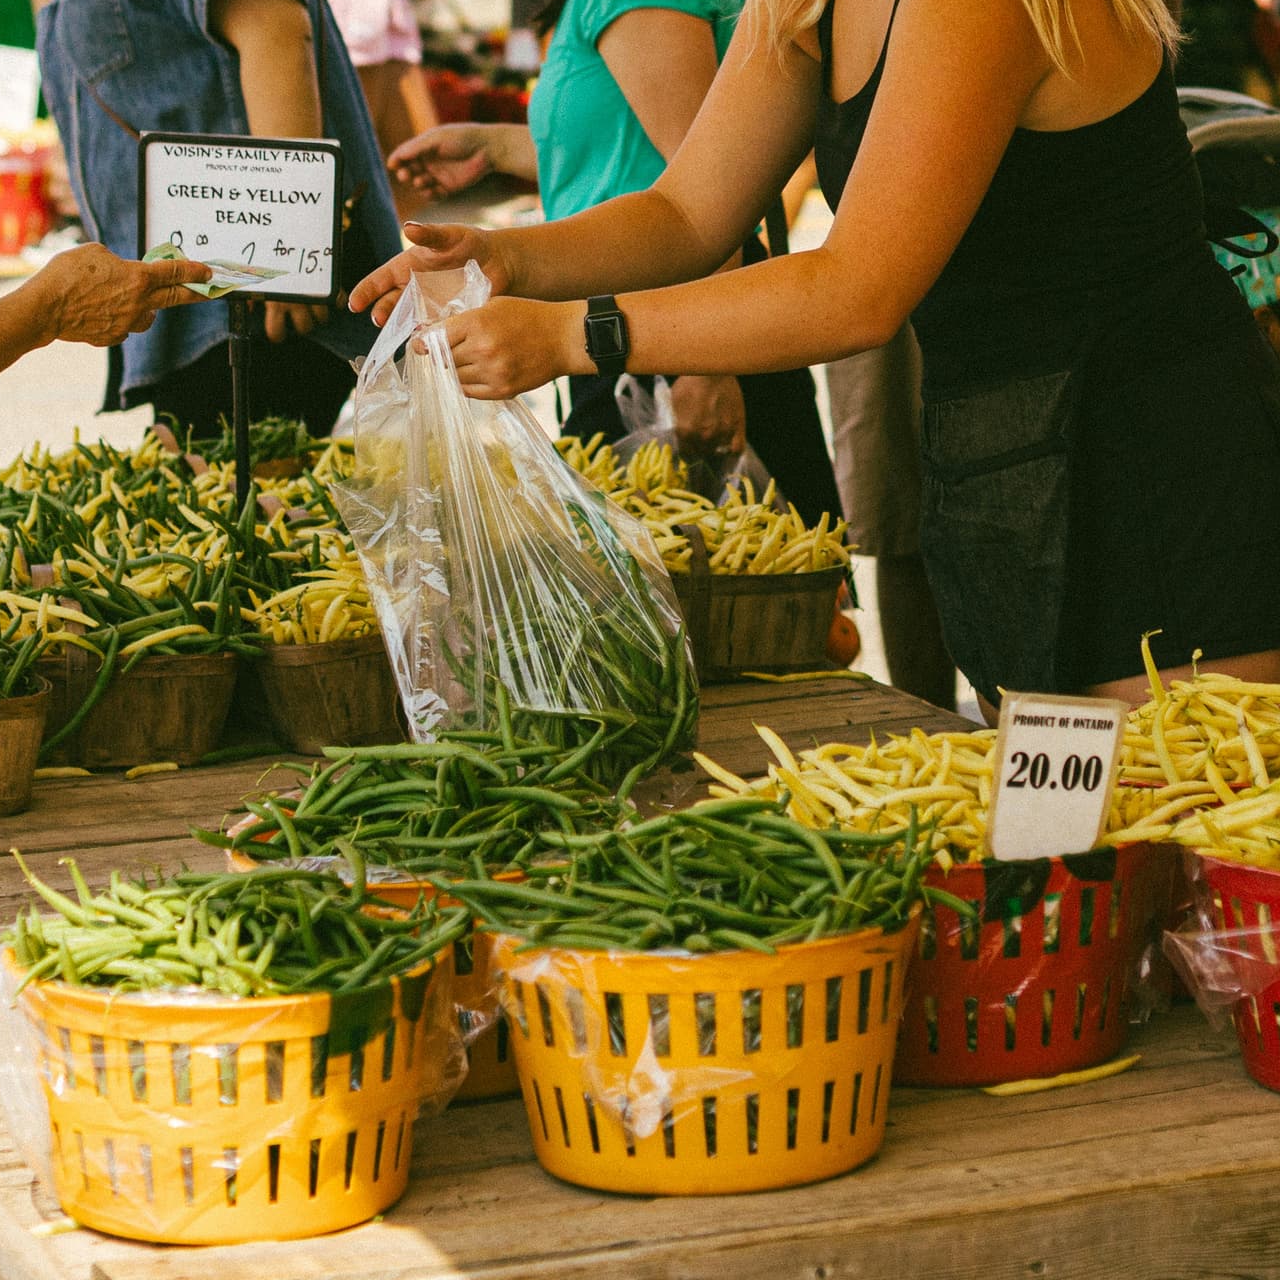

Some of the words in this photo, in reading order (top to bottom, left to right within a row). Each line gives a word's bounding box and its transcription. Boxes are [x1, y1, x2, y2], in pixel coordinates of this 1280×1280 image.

[163, 145, 223, 159] VOISIN'S
[227, 148, 280, 161] FAMILY
[284, 151, 325, 163] FARM
[167, 183, 223, 200] GREEN
[229, 187, 240, 200] &
[246, 188, 322, 205] YELLOW
[215, 210, 273, 226] BEANS
[273, 238, 296, 256] for
[1012, 714, 1057, 728] PRODUCT
[1058, 717, 1071, 729] OF
[1073, 718, 1114, 731] ONTARIO
[1006, 751, 1103, 793] 20.00
